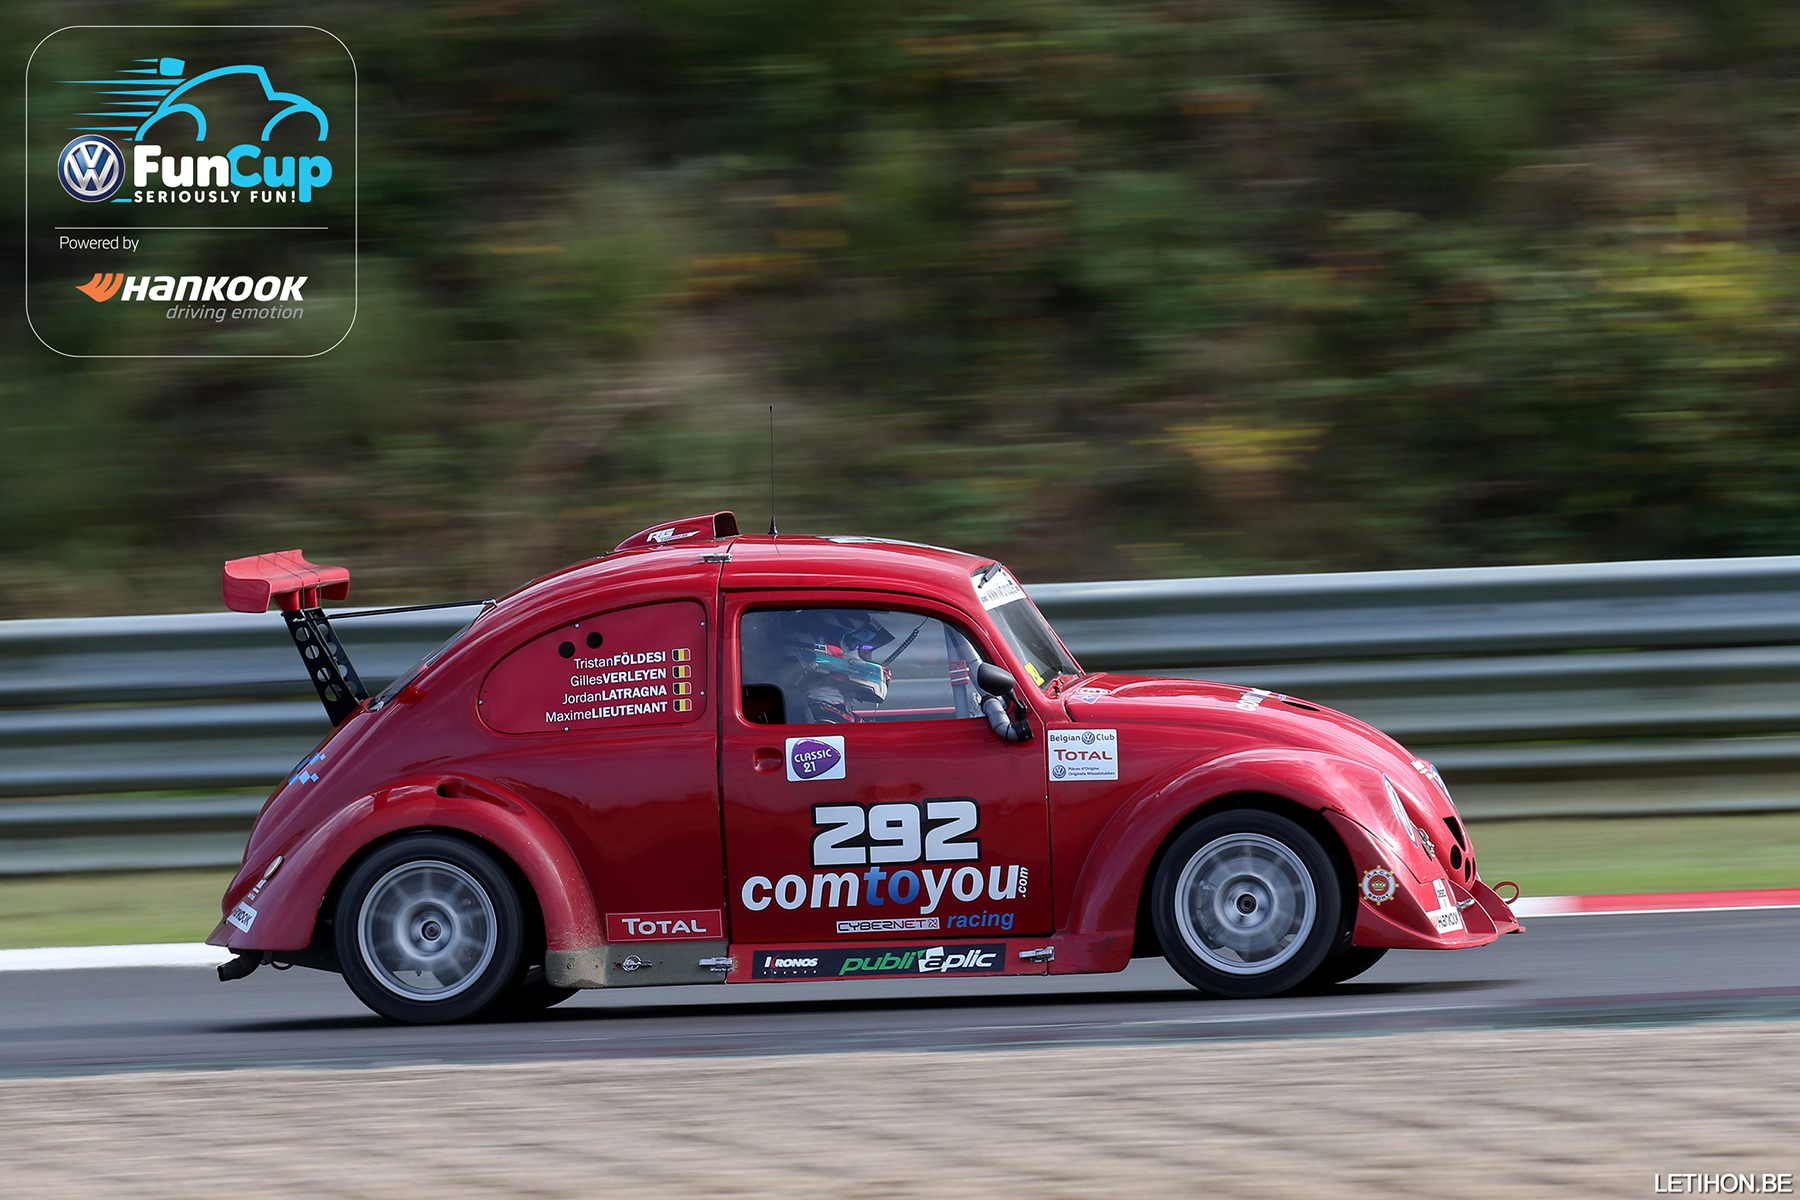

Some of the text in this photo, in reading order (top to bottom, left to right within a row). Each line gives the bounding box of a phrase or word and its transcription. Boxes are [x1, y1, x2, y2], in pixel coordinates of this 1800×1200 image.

[1050, 734, 1081, 744] Belgian
[1096, 733, 1115, 741] Club
[794, 748, 832, 763] CLASSIC
[1053, 749, 1113, 761] TOTAL
[803, 761, 816, 773] 21
[813, 800, 979, 866] 292
[741, 864, 1019, 915] comtoyou
[1367, 892, 1389, 901] SPORT
[621, 918, 707, 935] TOTAL
[947, 910, 1015, 930] racing
[764, 953, 818, 968] KRONOS
